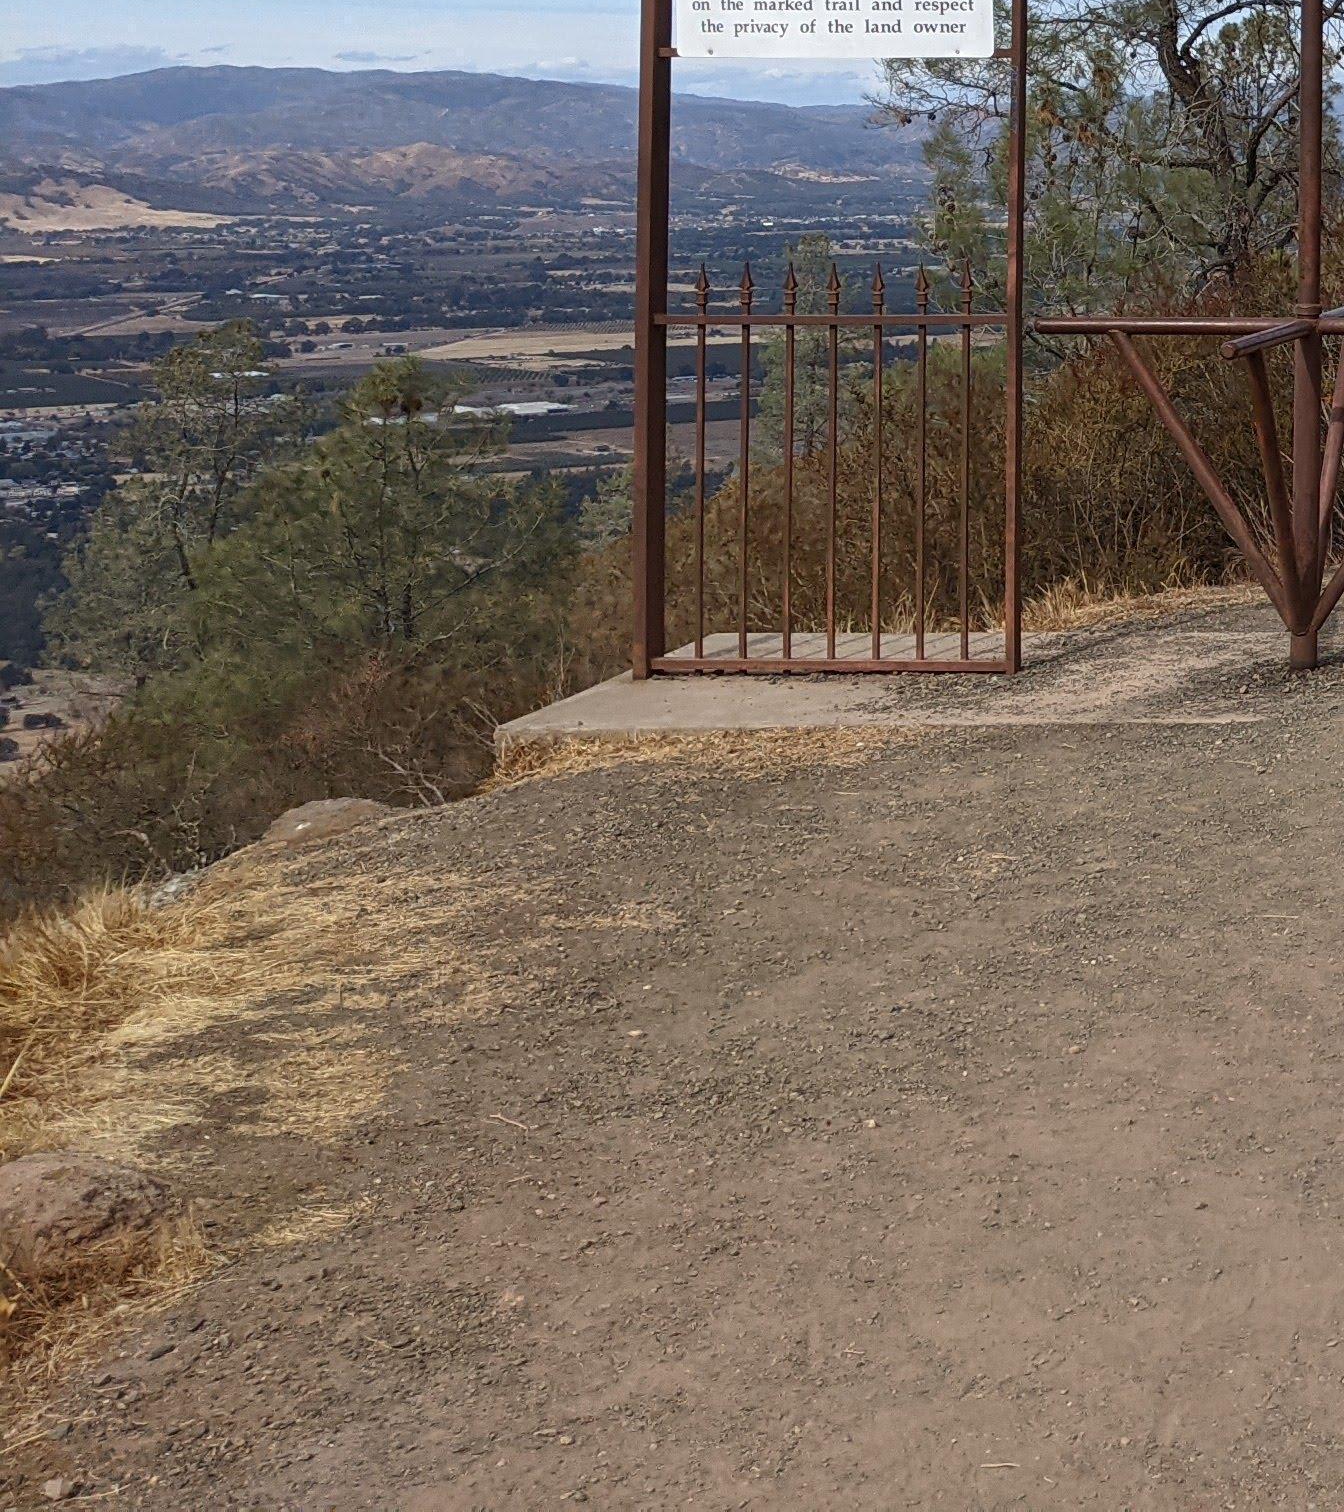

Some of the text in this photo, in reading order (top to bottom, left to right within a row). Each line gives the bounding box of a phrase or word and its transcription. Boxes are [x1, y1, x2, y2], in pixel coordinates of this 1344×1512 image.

[692, 0, 711, 11] on
[701, 19, 967, 37] the privacy of the land owner
